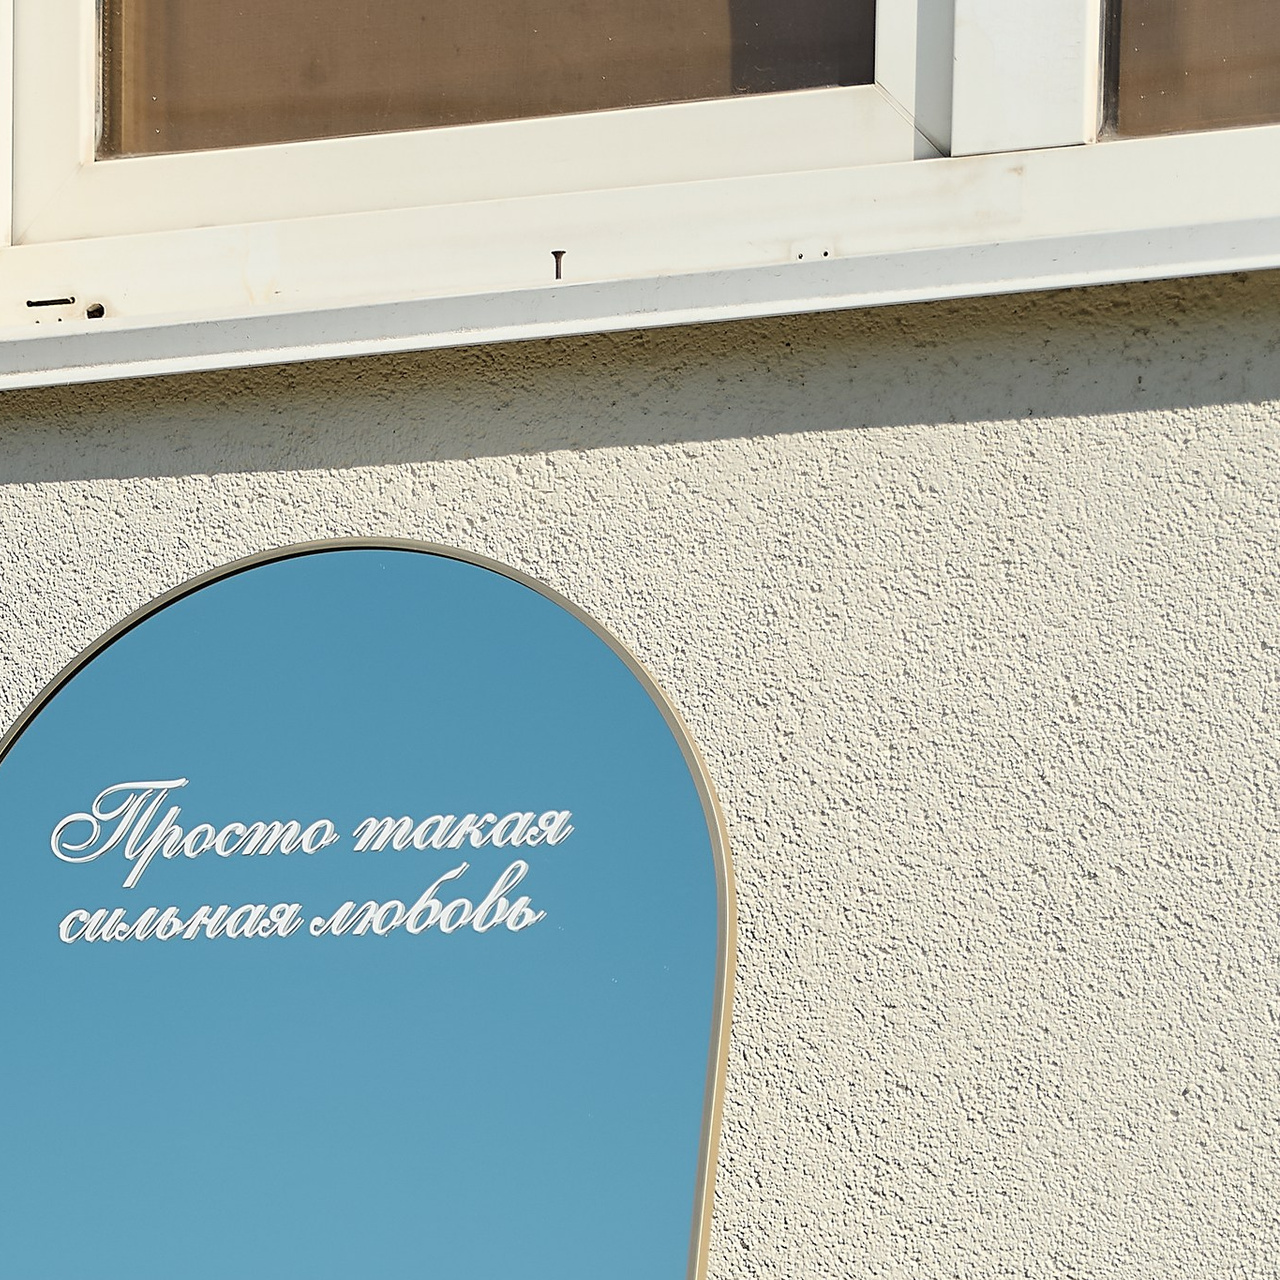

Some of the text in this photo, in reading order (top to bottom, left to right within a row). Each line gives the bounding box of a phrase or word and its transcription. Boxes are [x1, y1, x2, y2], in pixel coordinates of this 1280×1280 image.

[50, 777, 575, 889] Просто такая
[58, 859, 548, 943] сильная любовь
